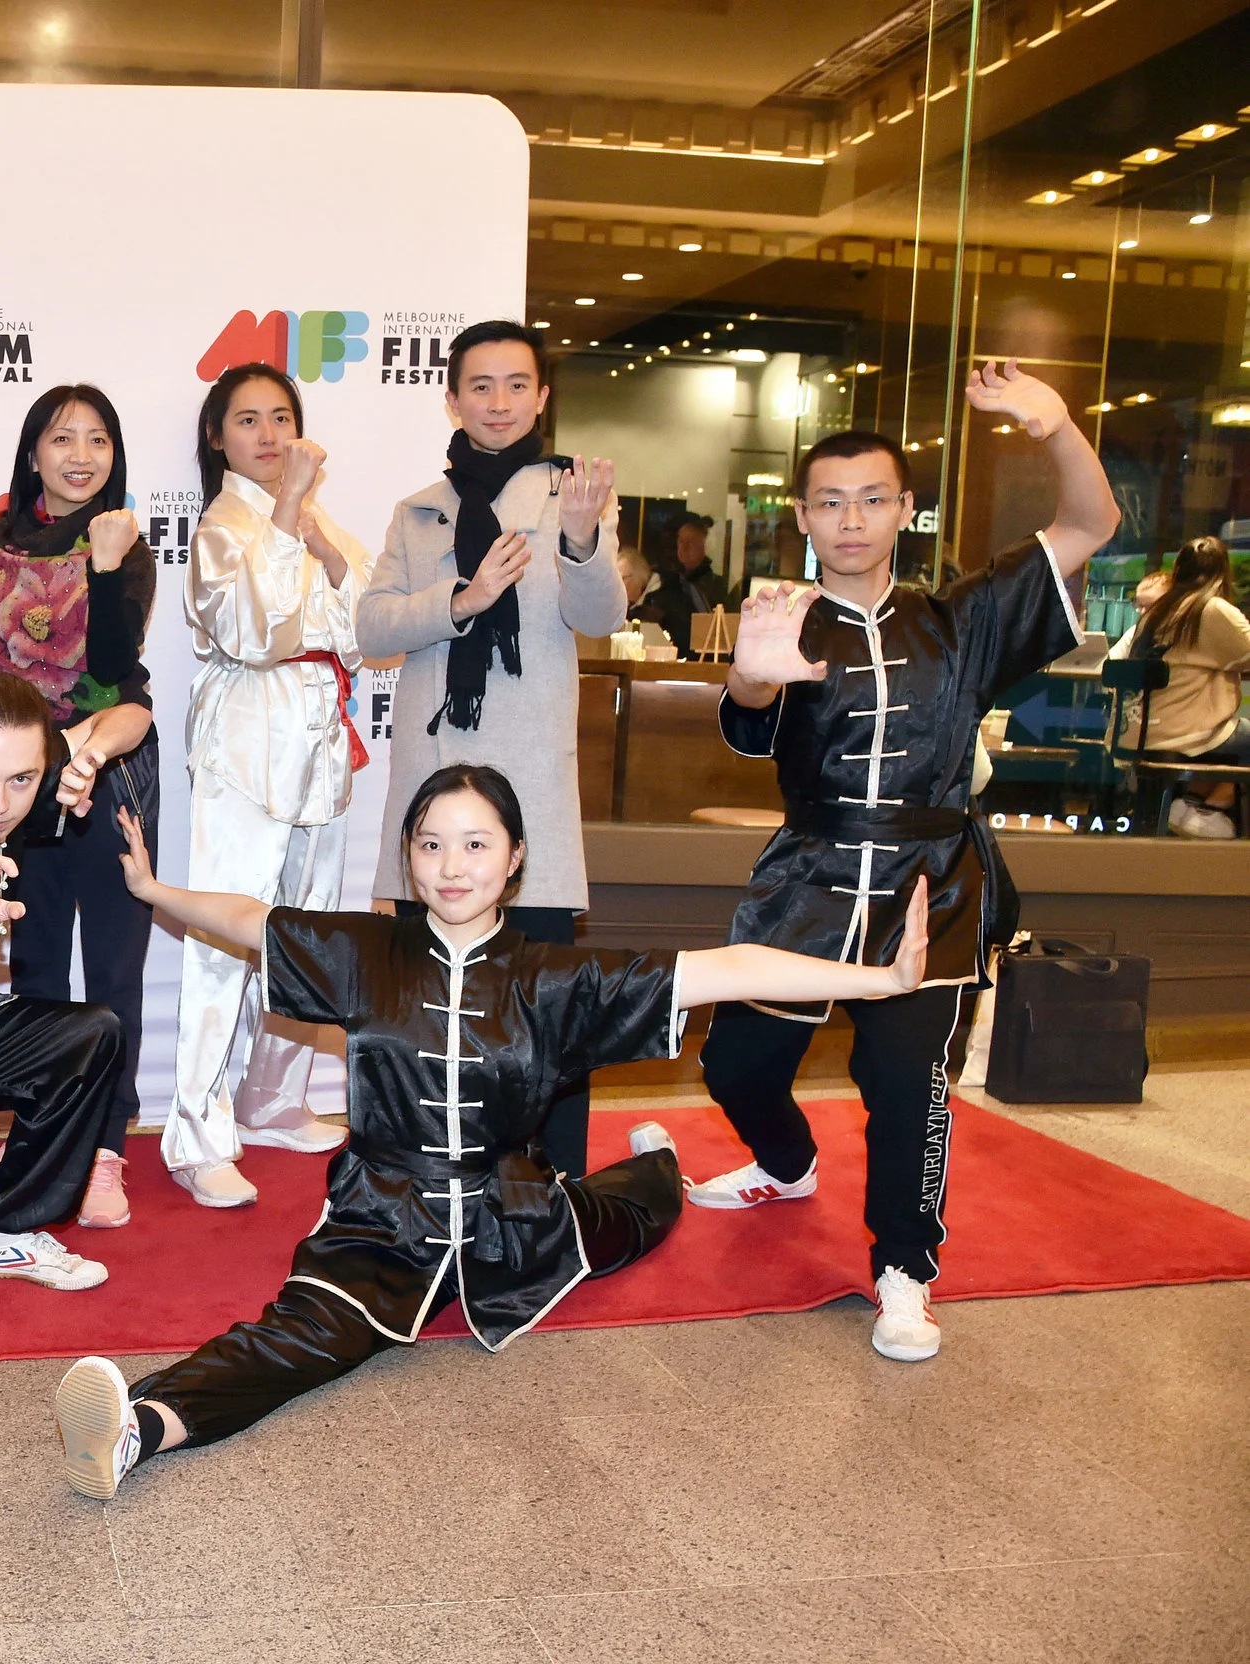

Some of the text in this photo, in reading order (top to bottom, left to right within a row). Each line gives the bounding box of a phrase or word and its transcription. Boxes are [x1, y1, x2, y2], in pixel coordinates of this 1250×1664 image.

[383, 312, 465, 323] MELBOURNE
[383, 325, 465, 335] INTERNATIO
[382, 337, 447, 367] FIL
[381, 369, 444, 384] FESTI
[150, 491, 204, 501] MELBOU
[150, 517, 188, 546] FI
